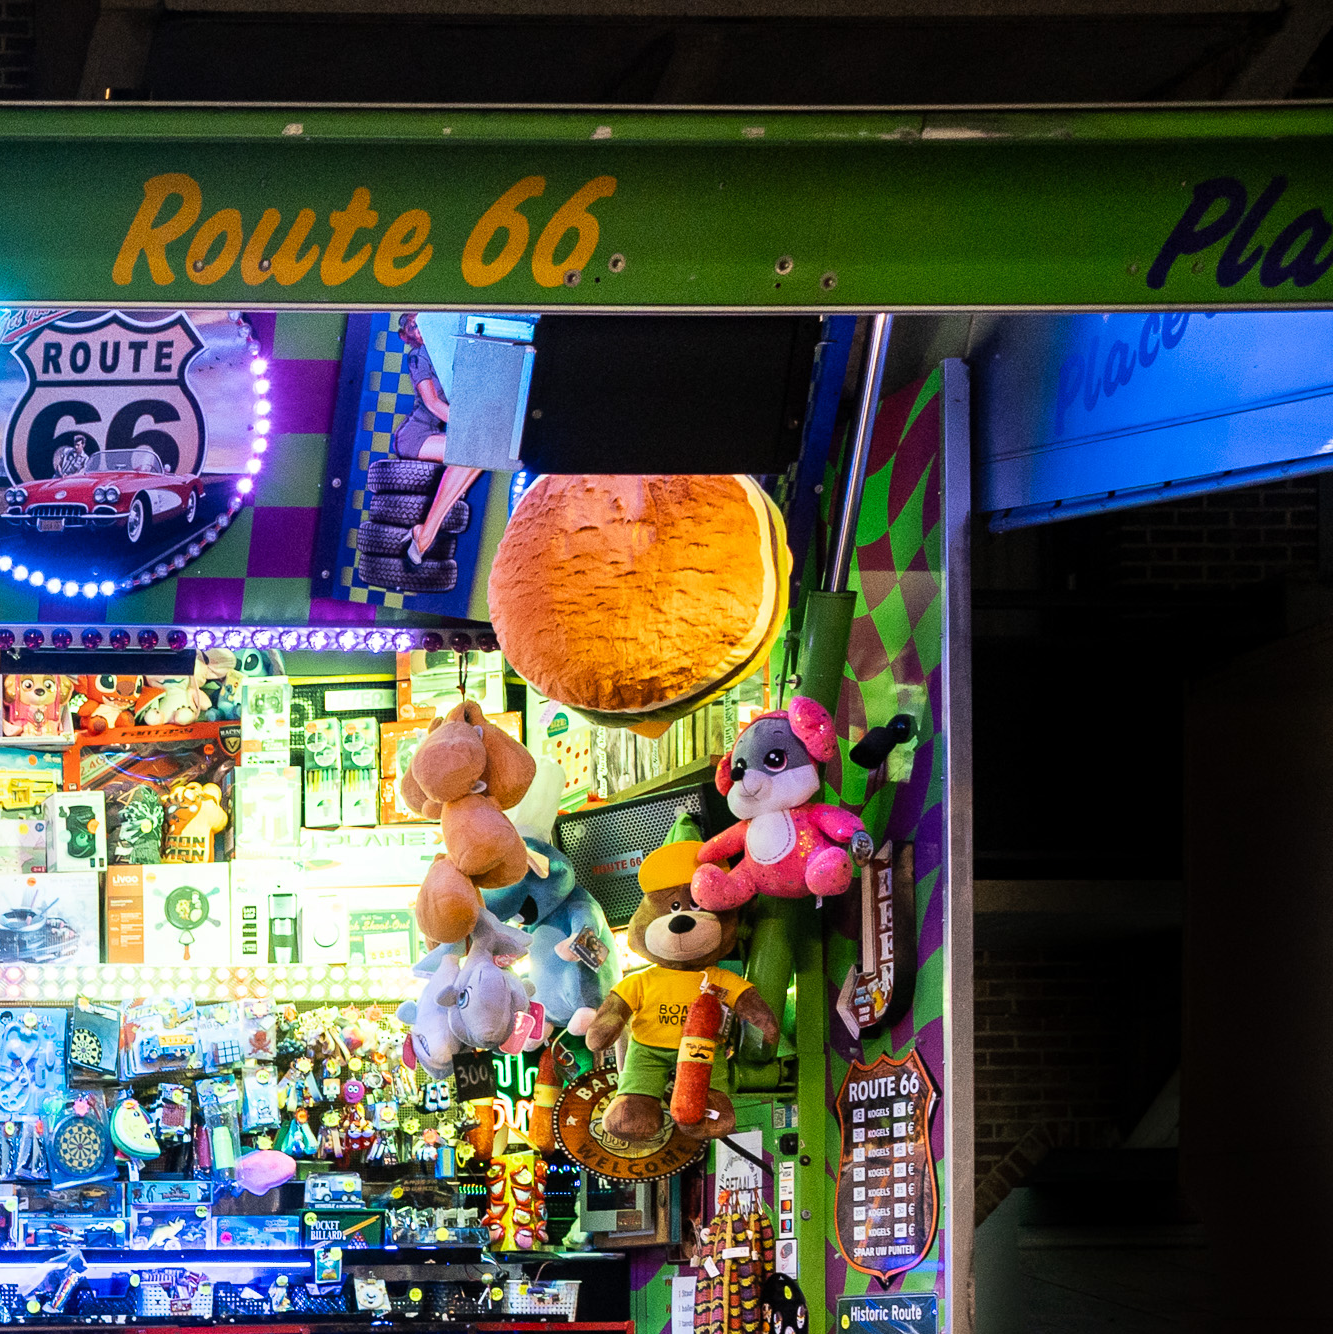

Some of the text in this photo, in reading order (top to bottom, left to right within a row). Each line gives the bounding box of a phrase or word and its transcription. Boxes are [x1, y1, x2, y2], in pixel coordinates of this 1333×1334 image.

[112, 174, 616, 288] Route 66
[41, 340, 174, 375] ROUTE
[26, 399, 181, 479] 66
[220, 728, 242, 737] RACIN
[630, 857, 643, 867] 66
[849, 1072, 919, 1102] ROUTE 66
[310, 1220, 340, 1231] POCKET
[851, 1304, 922, 1322] Historic Route
